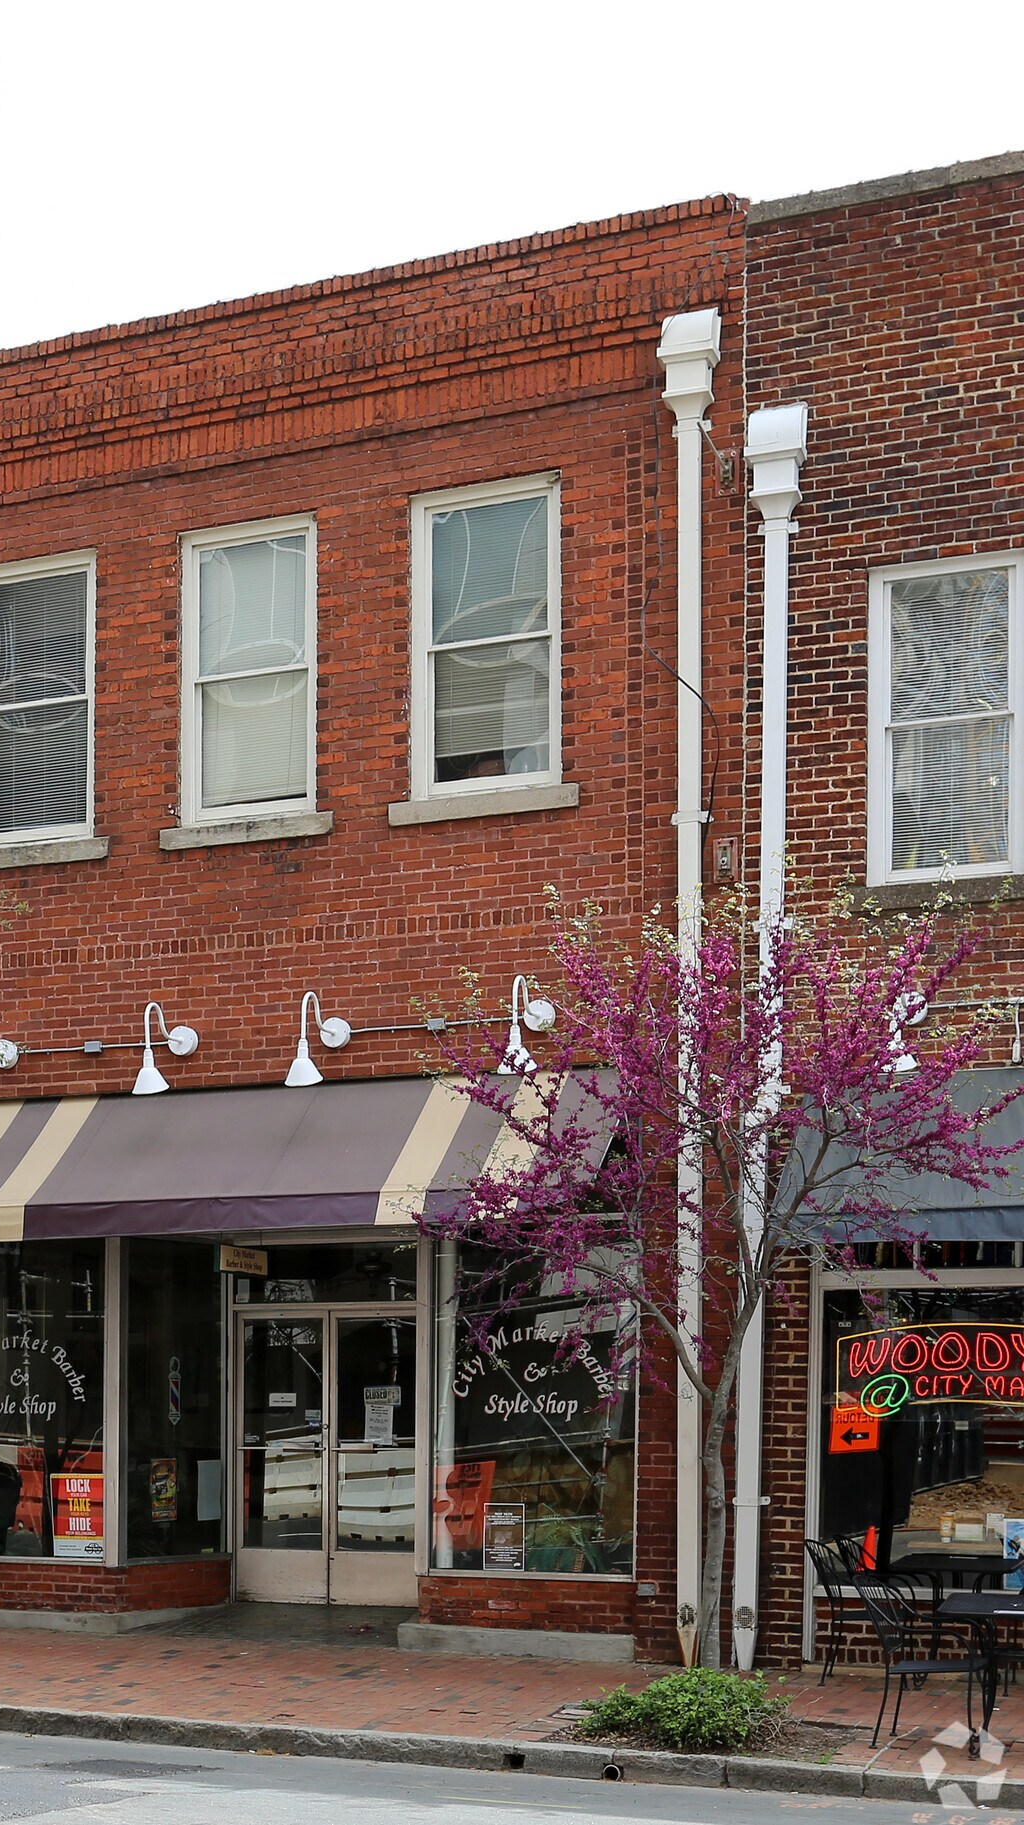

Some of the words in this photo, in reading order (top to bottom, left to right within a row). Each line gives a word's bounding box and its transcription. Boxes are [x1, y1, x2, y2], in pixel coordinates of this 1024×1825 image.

[10, 1368, 29, 1386] &
[50, 1345, 86, 1403] Barber
[452, 1355, 485, 1398] City
[524, 1362, 547, 1383] &
[365, 1388, 388, 1400] CLOSED
[860, 1374, 910, 1417] @
[915, 1375, 973, 1396] CITY
[19, 1394, 57, 1421] Shop
[484, 1391, 528, 1422] Style
[532, 1391, 578, 1422] Shop
[66, 1479, 91, 1493] LOCK
[67, 1498, 91, 1512] TAKE
[69, 1517, 92, 1531] HIDE
